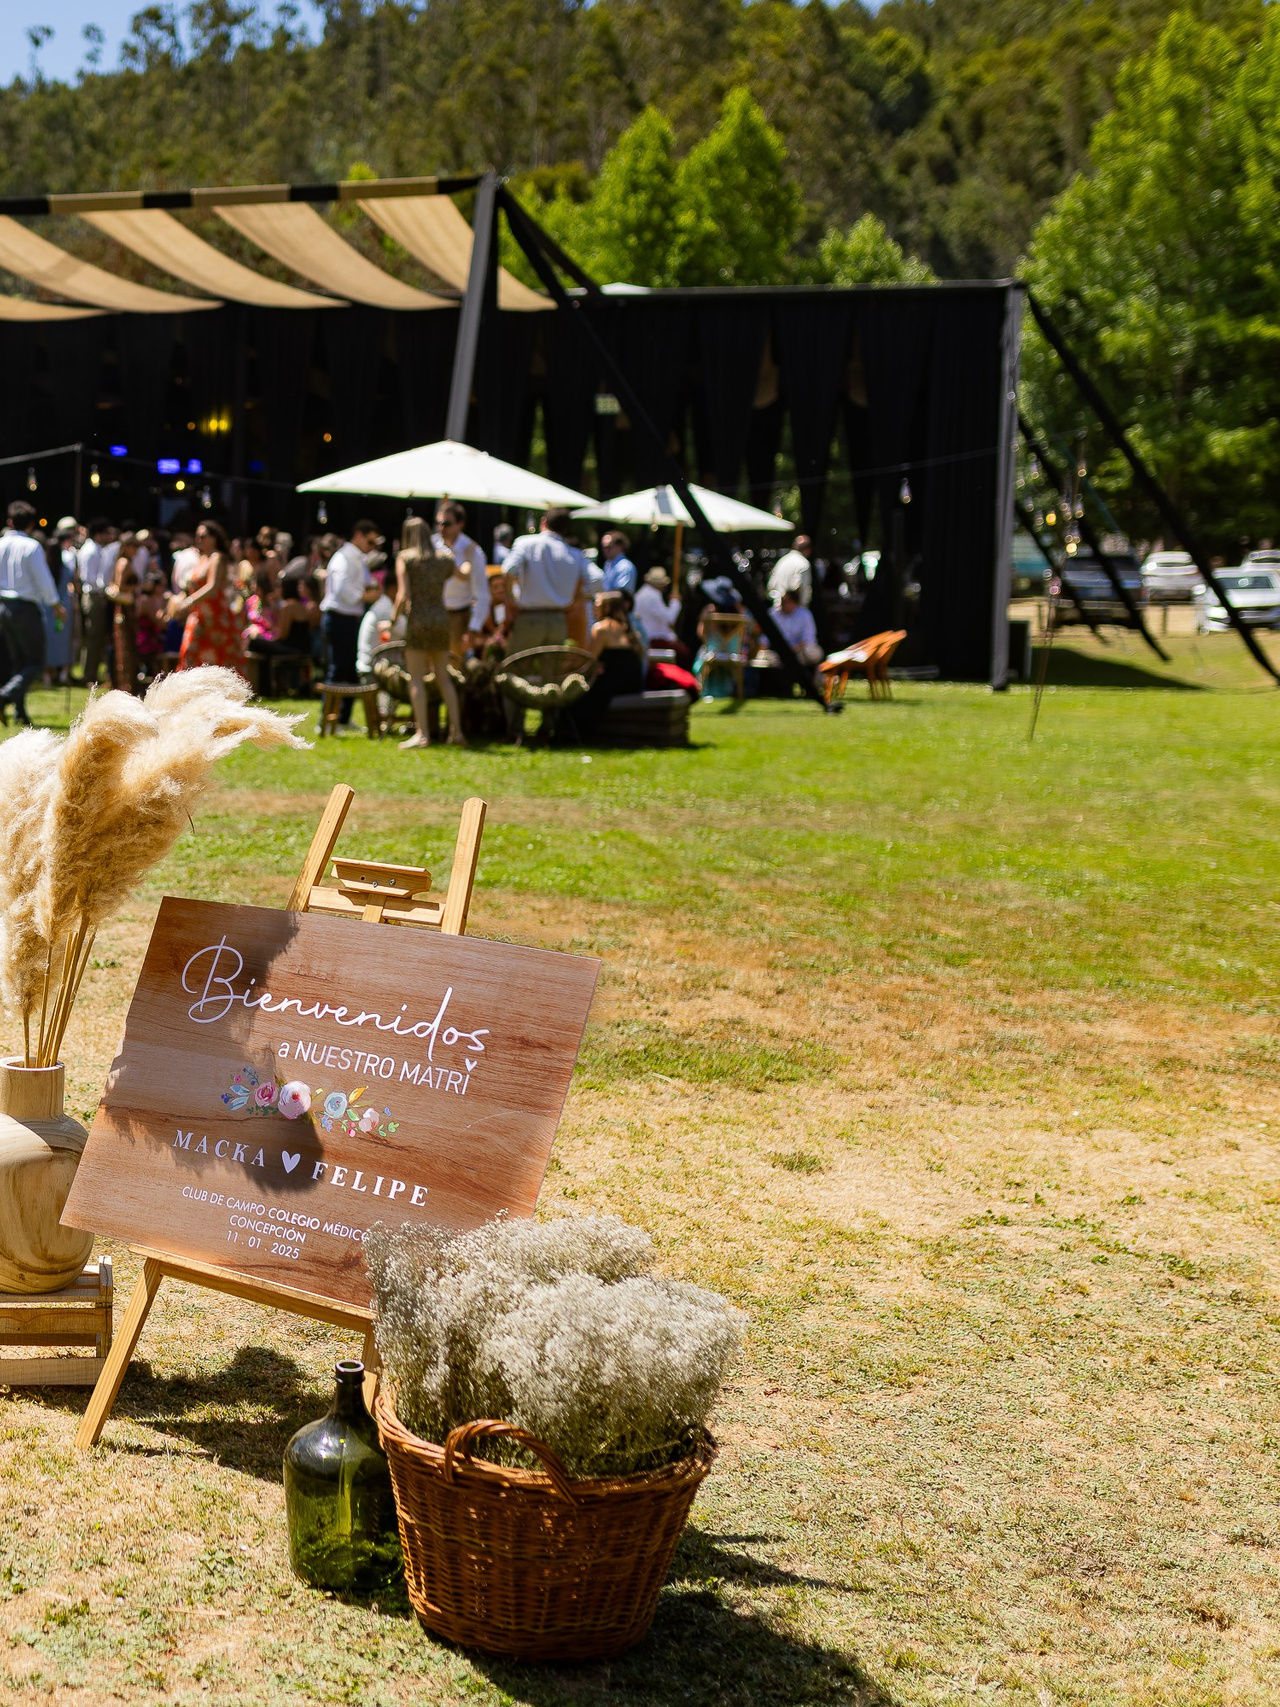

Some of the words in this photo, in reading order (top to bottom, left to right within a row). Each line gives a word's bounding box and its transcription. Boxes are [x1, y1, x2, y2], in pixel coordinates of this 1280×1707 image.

[181, 935, 490, 1062] Bienvenidos
[278, 1042, 289, 1058] a
[294, 1041, 395, 1079] NUESTRO
[172, 1129, 266, 1168] MACKA
[311, 1161, 429, 1207] FELIPE
[182, 1186, 208, 1202] CLUB
[209, 1192, 225, 1206] DE
[226, 1197, 266, 1216] CAMPO
[268, 1207, 321, 1230] COLEGIO
[226, 1230, 239, 1244] 11
[247, 1236, 262, 1250] 01
[271, 1243, 301, 1260] 2025
[229, 1214, 307, 1244] CONCEPCIÓN
